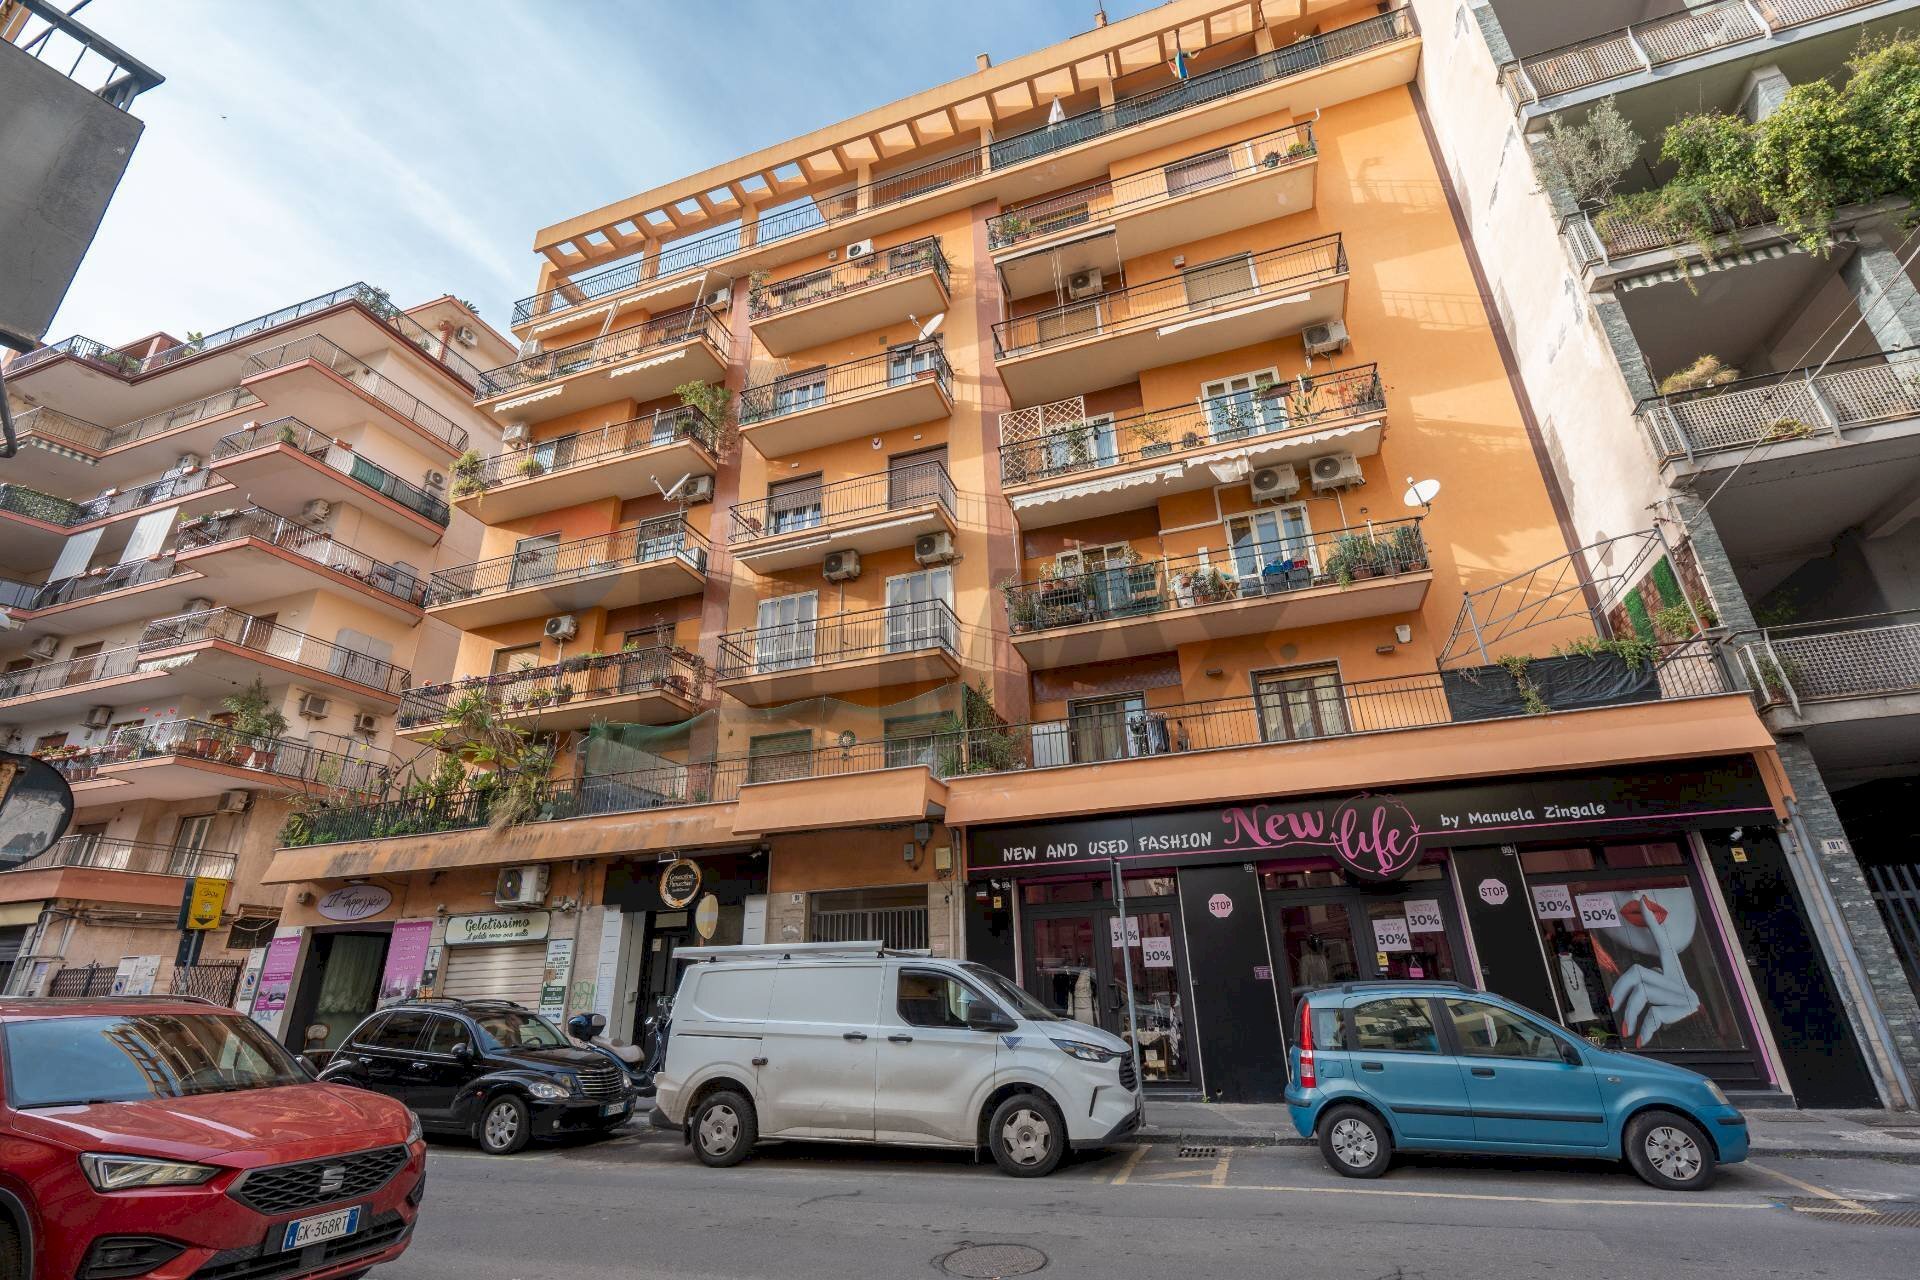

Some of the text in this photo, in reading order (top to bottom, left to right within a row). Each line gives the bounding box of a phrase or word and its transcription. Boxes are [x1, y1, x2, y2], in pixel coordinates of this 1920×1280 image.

[1440, 802, 1607, 829] by Manuela Zingale
[1221, 804, 1325, 846] New
[1003, 831, 1212, 862] NEW AND USED FASHION
[1481, 886, 1505, 896] STOP
[1210, 901, 1231, 910] STOP
[1538, 900, 1571, 912] 30%
[1409, 914, 1440, 926] 30%
[1583, 909, 1616, 921] 50%
[465, 917, 530, 932] Gelatissimo
[1378, 933, 1408, 945] 50%
[1145, 950, 1171, 961] 50%
